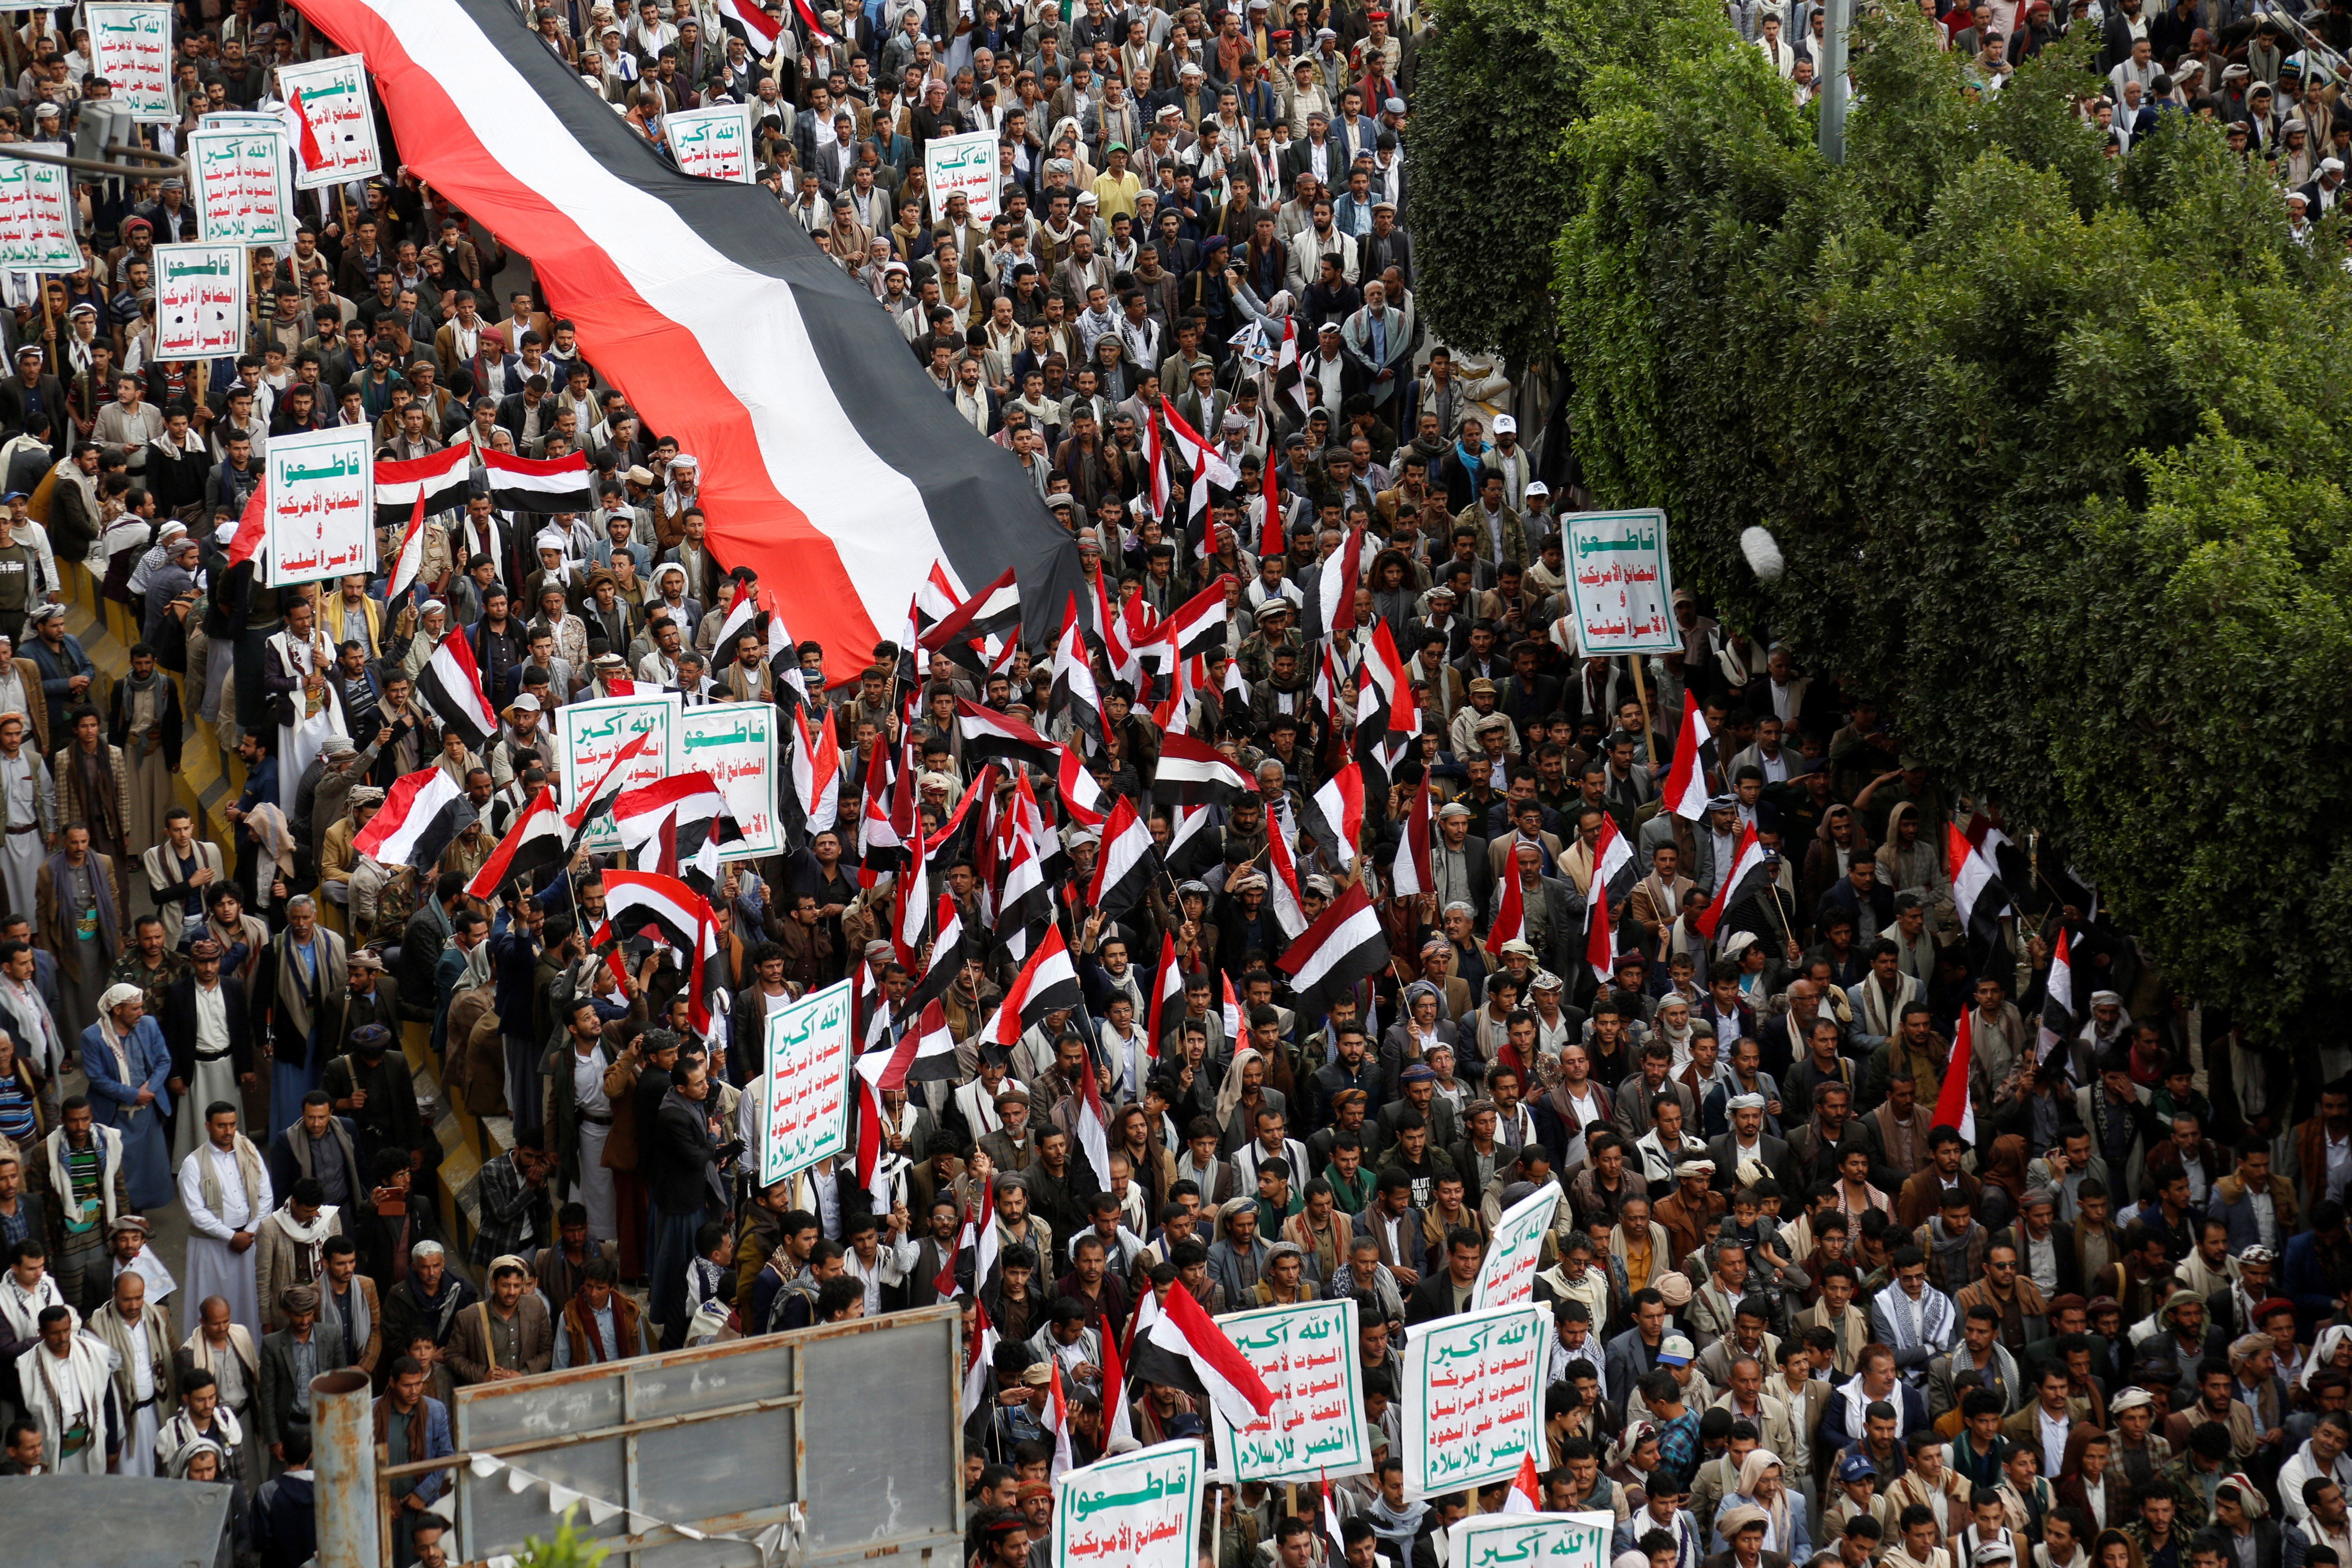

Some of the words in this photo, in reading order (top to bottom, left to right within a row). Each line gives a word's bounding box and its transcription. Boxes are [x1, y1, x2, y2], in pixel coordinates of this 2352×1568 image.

[98, 11, 147, 38] أكبر
[145, 14, 165, 34] الله
[100, 38, 132, 52] لأمريكا
[136, 43, 163, 54] الموت
[104, 59, 135, 74] لإسرائيل
[137, 62, 163, 73] الموت
[109, 78, 127, 91] اليه
[129, 79, 143, 91] على
[146, 80, 165, 92] اللعنة
[143, 98, 168, 113] النصر
[332, 104, 364, 125] البضائع
[331, 131, 335, 144] و
[677, 121, 713, 149] أكبر
[716, 122, 740, 139] الله
[203, 138, 244, 166] أكبر
[247, 140, 274, 158] الله
[713, 145, 742, 161] الموت
[933, 145, 976, 176] أكبر
[973, 145, 991, 164] الله
[34, 164, 60, 183] الله
[204, 163, 241, 181] لأمريكا
[244, 166, 274, 179] الموت
[715, 164, 744, 179] الموت
[935, 173, 964, 190] لأمريكا
[967, 172, 991, 186] الموت
[0, 186, 30, 205] لأمريك
[34, 191, 61, 203] الموت
[207, 183, 243, 202] لإسرائيل
[246, 185, 276, 198] الموت
[969, 191, 991, 206] الموت
[0, 207, 33, 224] لإسرائي
[37, 209, 64, 222] الموت
[208, 203, 233, 219] اليهود
[237, 202, 251, 216] على
[255, 202, 278, 215] اللعنة
[977, 210, 994, 221] اللعنة
[29, 227, 43, 241] على
[47, 226, 69, 240] اللعنة
[209, 219, 245, 241] للإسلام
[249, 218, 281, 238] النصر
[45, 243, 76, 263] النصر
[163, 254, 229, 283] قاطعوا
[163, 282, 198, 309] الأمريكية
[201, 284, 236, 307] البضائع
[194, 307, 198, 324] و
[163, 330, 236, 352] الإسرائيلية
[280, 451, 359, 488] قاطعوا
[276, 490, 322, 519] الأمريكية
[324, 489, 363, 515] البضائع
[317, 522, 322, 539] و
[1574, 527, 1655, 559] قاطعوا
[280, 543, 363, 575] الإسرائيلية
[1578, 560, 1621, 588] الأمريكية
[1624, 563, 1657, 585] البضائع
[1620, 590, 1626, 607] و
[1586, 615, 1667, 639] الإسرائيلية
[574, 710, 628, 746] أكبر
[630, 711, 664, 733] الله
[683, 719, 765, 755] قاطعو
[728, 757, 765, 783] البضائع
[821, 997, 846, 1030] الله
[775, 1005, 819, 1056] أكبر
[816, 1033, 844, 1063] الموت
[775, 1045, 813, 1080] لأمريكا
[815, 1062, 843, 1092] الموت
[774, 1077, 813, 1113] لإسرائيل
[821, 1089, 842, 1116] اللعنة
[772, 1111, 800, 1140] اليهود
[803, 1105, 817, 1129] على
[808, 1116, 840, 1156] النصر
[770, 1133, 808, 1174] للإسلام
[1487, 1255, 1517, 1291] لأمريكا
[1235, 1316, 1294, 1357] أكبر
[1298, 1314, 1341, 1340] الله
[1497, 1319, 1537, 1345] الله
[1430, 1323, 1497, 1367] أكبر
[1294, 1346, 1342, 1370] الموت
[1490, 1349, 1534, 1375] الموت
[1296, 1372, 1344, 1398] الموت
[1430, 1358, 1485, 1390] لأمريكا
[1489, 1375, 1532, 1402] الموت
[1311, 1398, 1347, 1422] اللعنة
[1430, 1388, 1484, 1420] لإسرائيل
[1499, 1400, 1530, 1424] اللعنة
[1283, 1408, 1304, 1432] على
[1472, 1414, 1492, 1437] على
[1301, 1425, 1350, 1464] النصر
[1429, 1421, 1468, 1448] اليهود
[1241, 1435, 1294, 1473] للإسلام
[1486, 1428, 1531, 1467] النصر
[1430, 1440, 1481, 1483] للإسلام
[1071, 1466, 1186, 1522] قاطعوا
[1069, 1520, 1131, 1561] الأمريكية
[1135, 1512, 1183, 1555] البضائع
[1550, 1528, 1595, 1555] الله
[1472, 1528, 1548, 1568] أكبر
